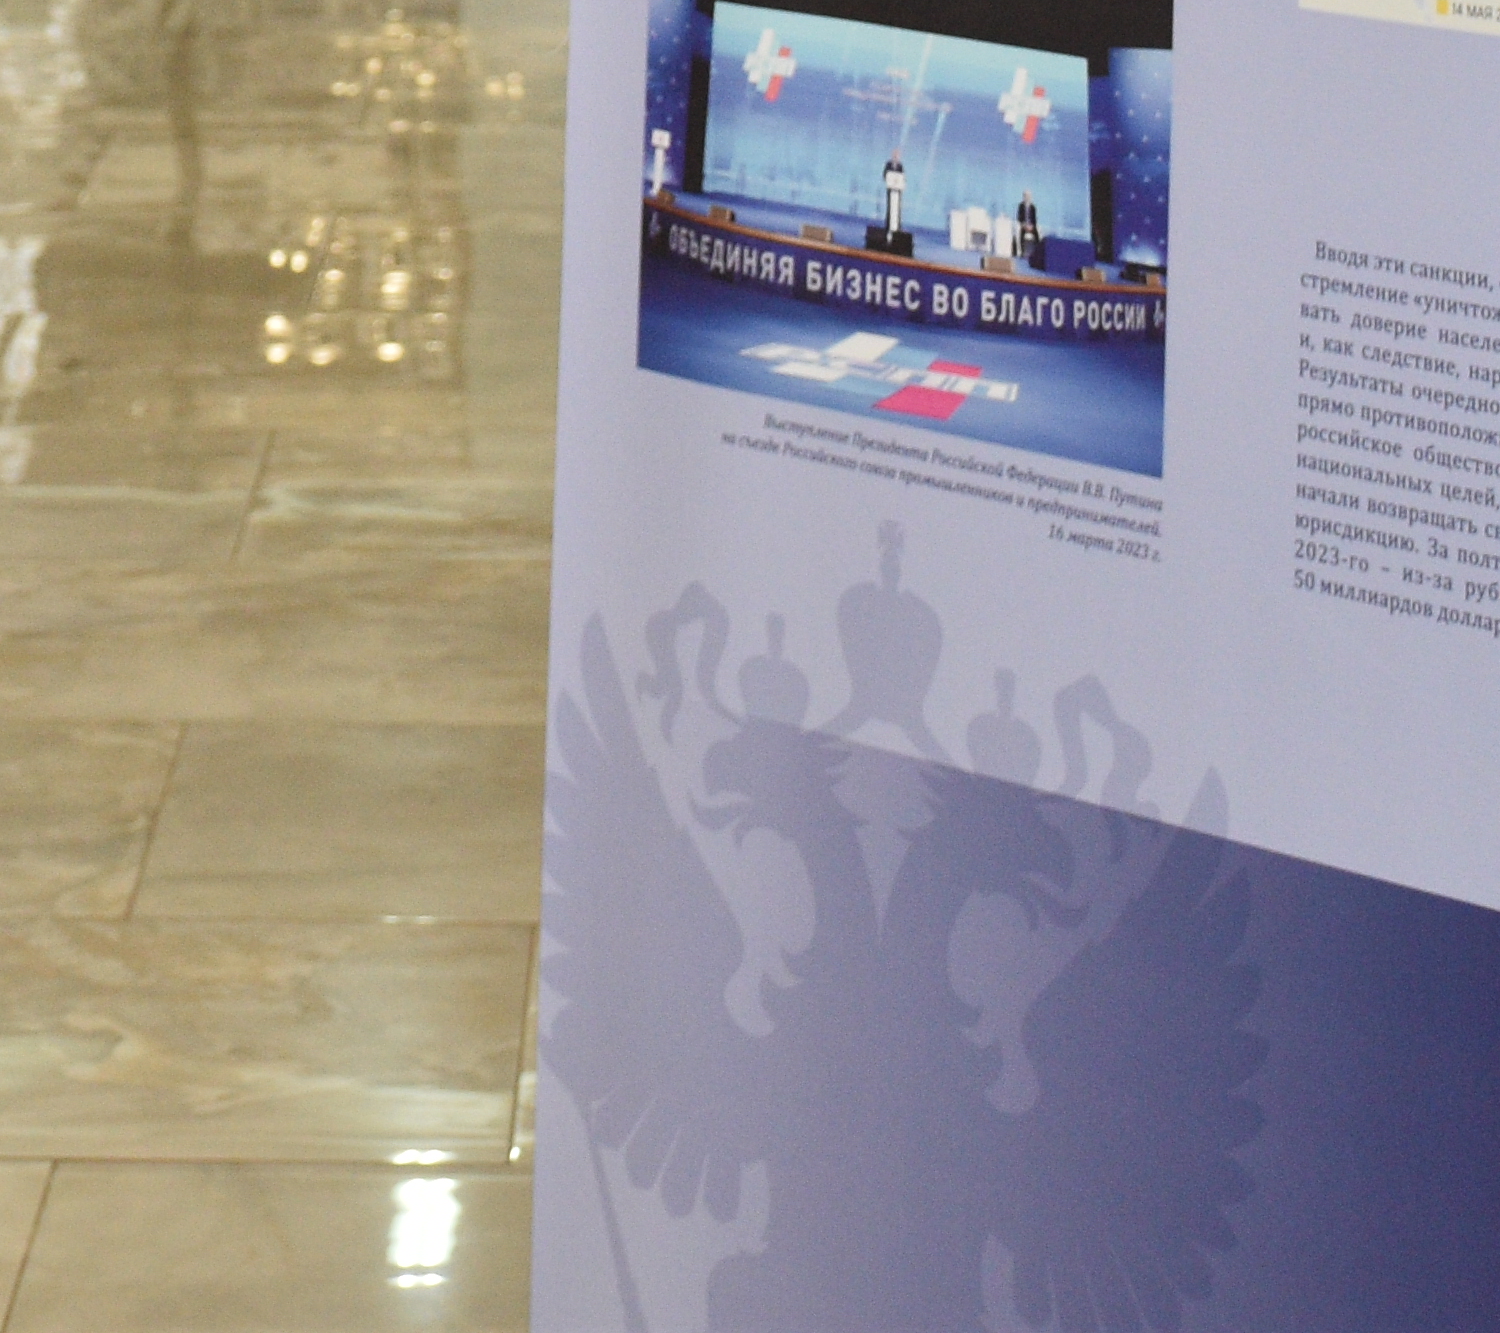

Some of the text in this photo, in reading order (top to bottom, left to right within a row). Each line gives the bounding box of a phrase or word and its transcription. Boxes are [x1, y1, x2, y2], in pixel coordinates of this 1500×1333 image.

[1452, 2, 1464, 16] 14
[1465, 3, 1494, 20] МАЯ
[668, 224, 1147, 333] ОБЪЕДИНЯЯ БИЗНЕС ВО БЛАГО РОССИИ
[1314, 239, 1370, 270] Вводя
[1373, 255, 1406, 276] эти
[1409, 261, 1494, 294] санкции,
